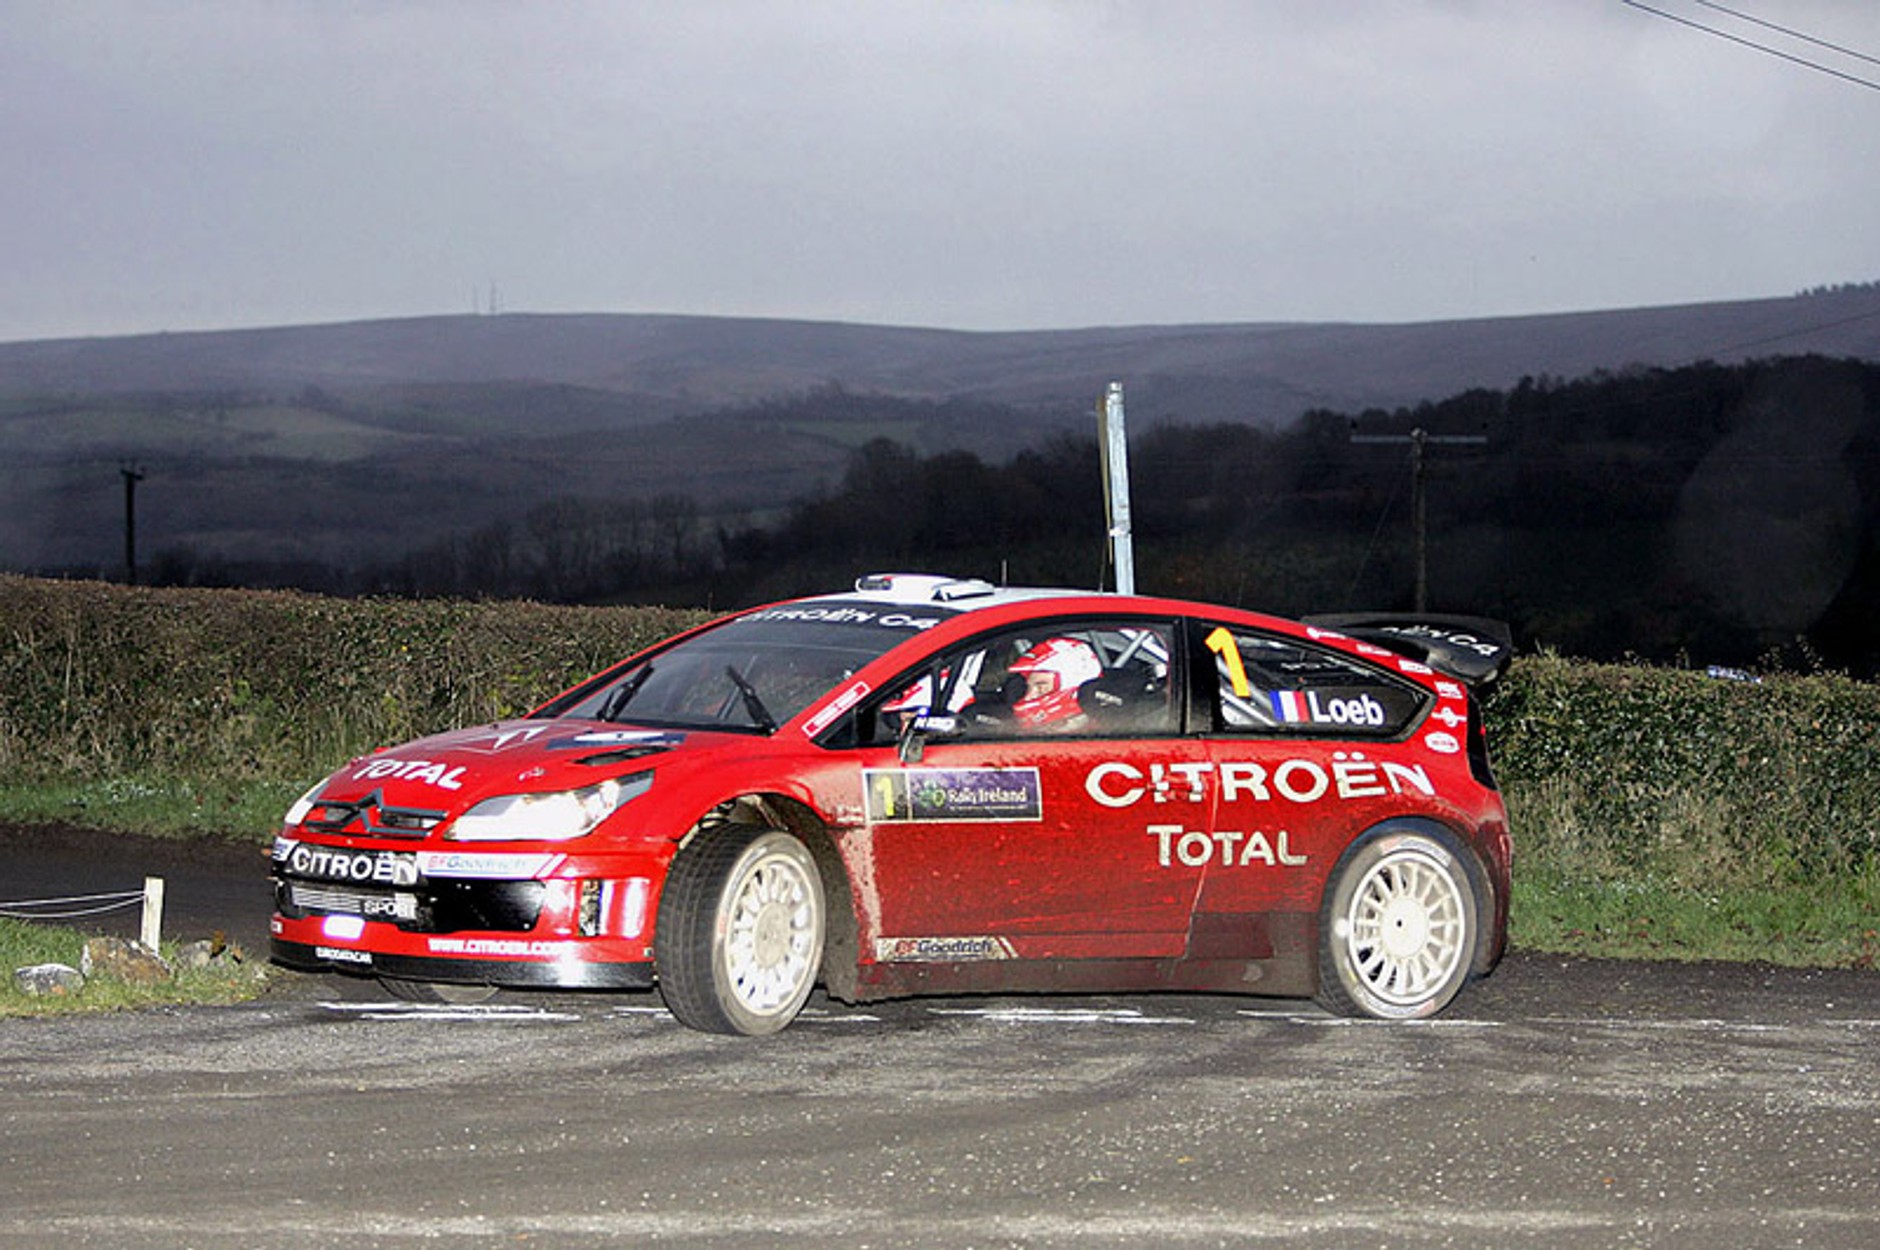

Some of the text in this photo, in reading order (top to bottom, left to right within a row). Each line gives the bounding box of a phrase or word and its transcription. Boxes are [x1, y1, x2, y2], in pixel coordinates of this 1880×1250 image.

[1204, 626, 1251, 698] 1
[1307, 690, 1384, 725] Loeb
[353, 758, 467, 790] TOTAL
[1085, 752, 1436, 807] CITROËN
[875, 776, 895, 817] 1
[947, 786, 1027, 805] Rally Ireland
[292, 846, 419, 885] CITROËN
[1147, 824, 1308, 867] TOTAL
